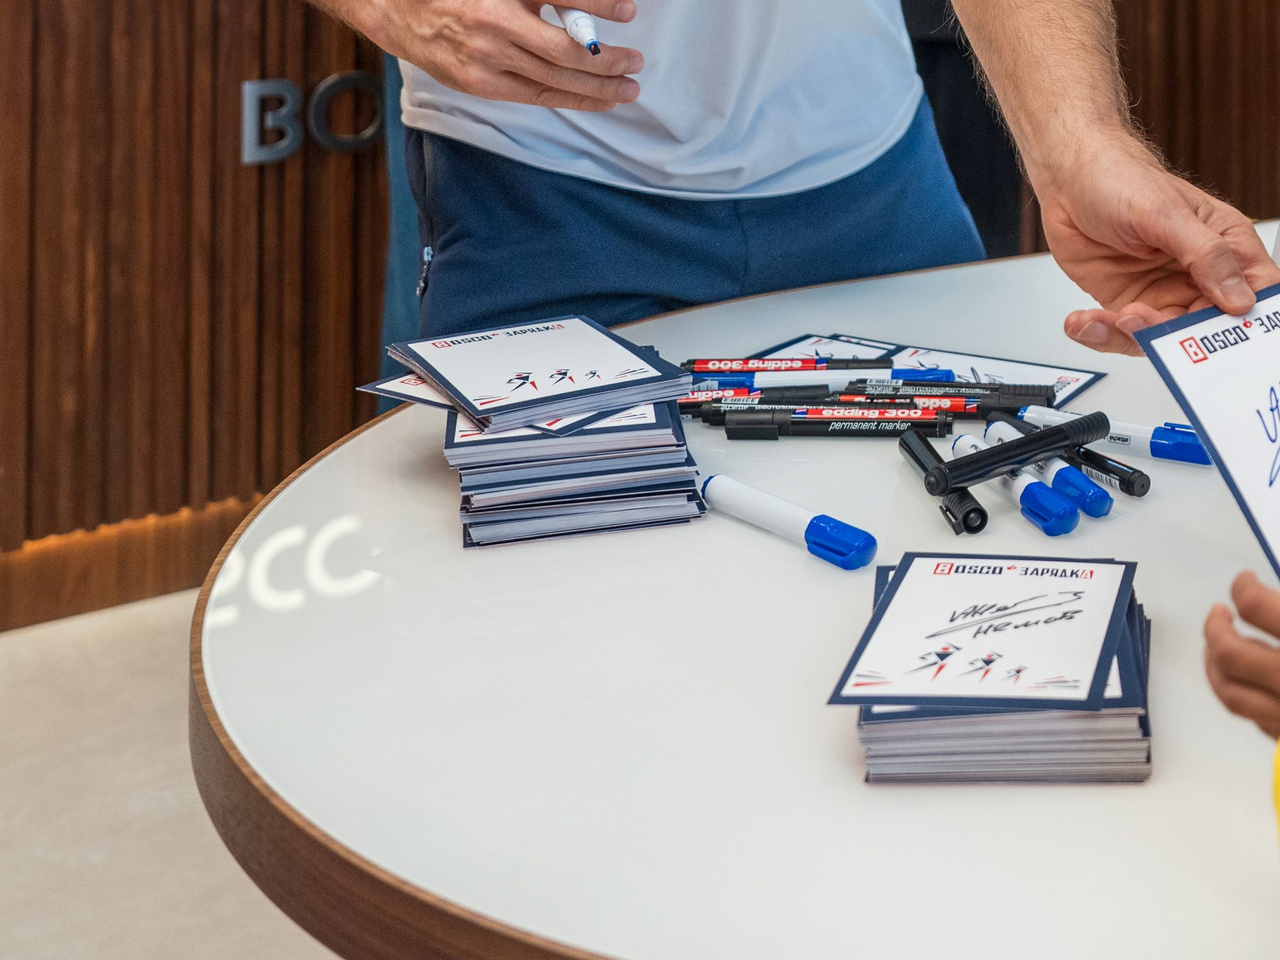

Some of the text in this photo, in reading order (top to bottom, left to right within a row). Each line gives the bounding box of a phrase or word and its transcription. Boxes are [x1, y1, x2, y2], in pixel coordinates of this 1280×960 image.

[1179, 325, 1250, 364] BOSCO
[707, 359, 803, 371] edding 300
[822, 408, 922, 418] edding 300
[829, 420, 912, 432] permanent marker
[933, 562, 1094, 580] BOSCO ЗАРЯДКА
